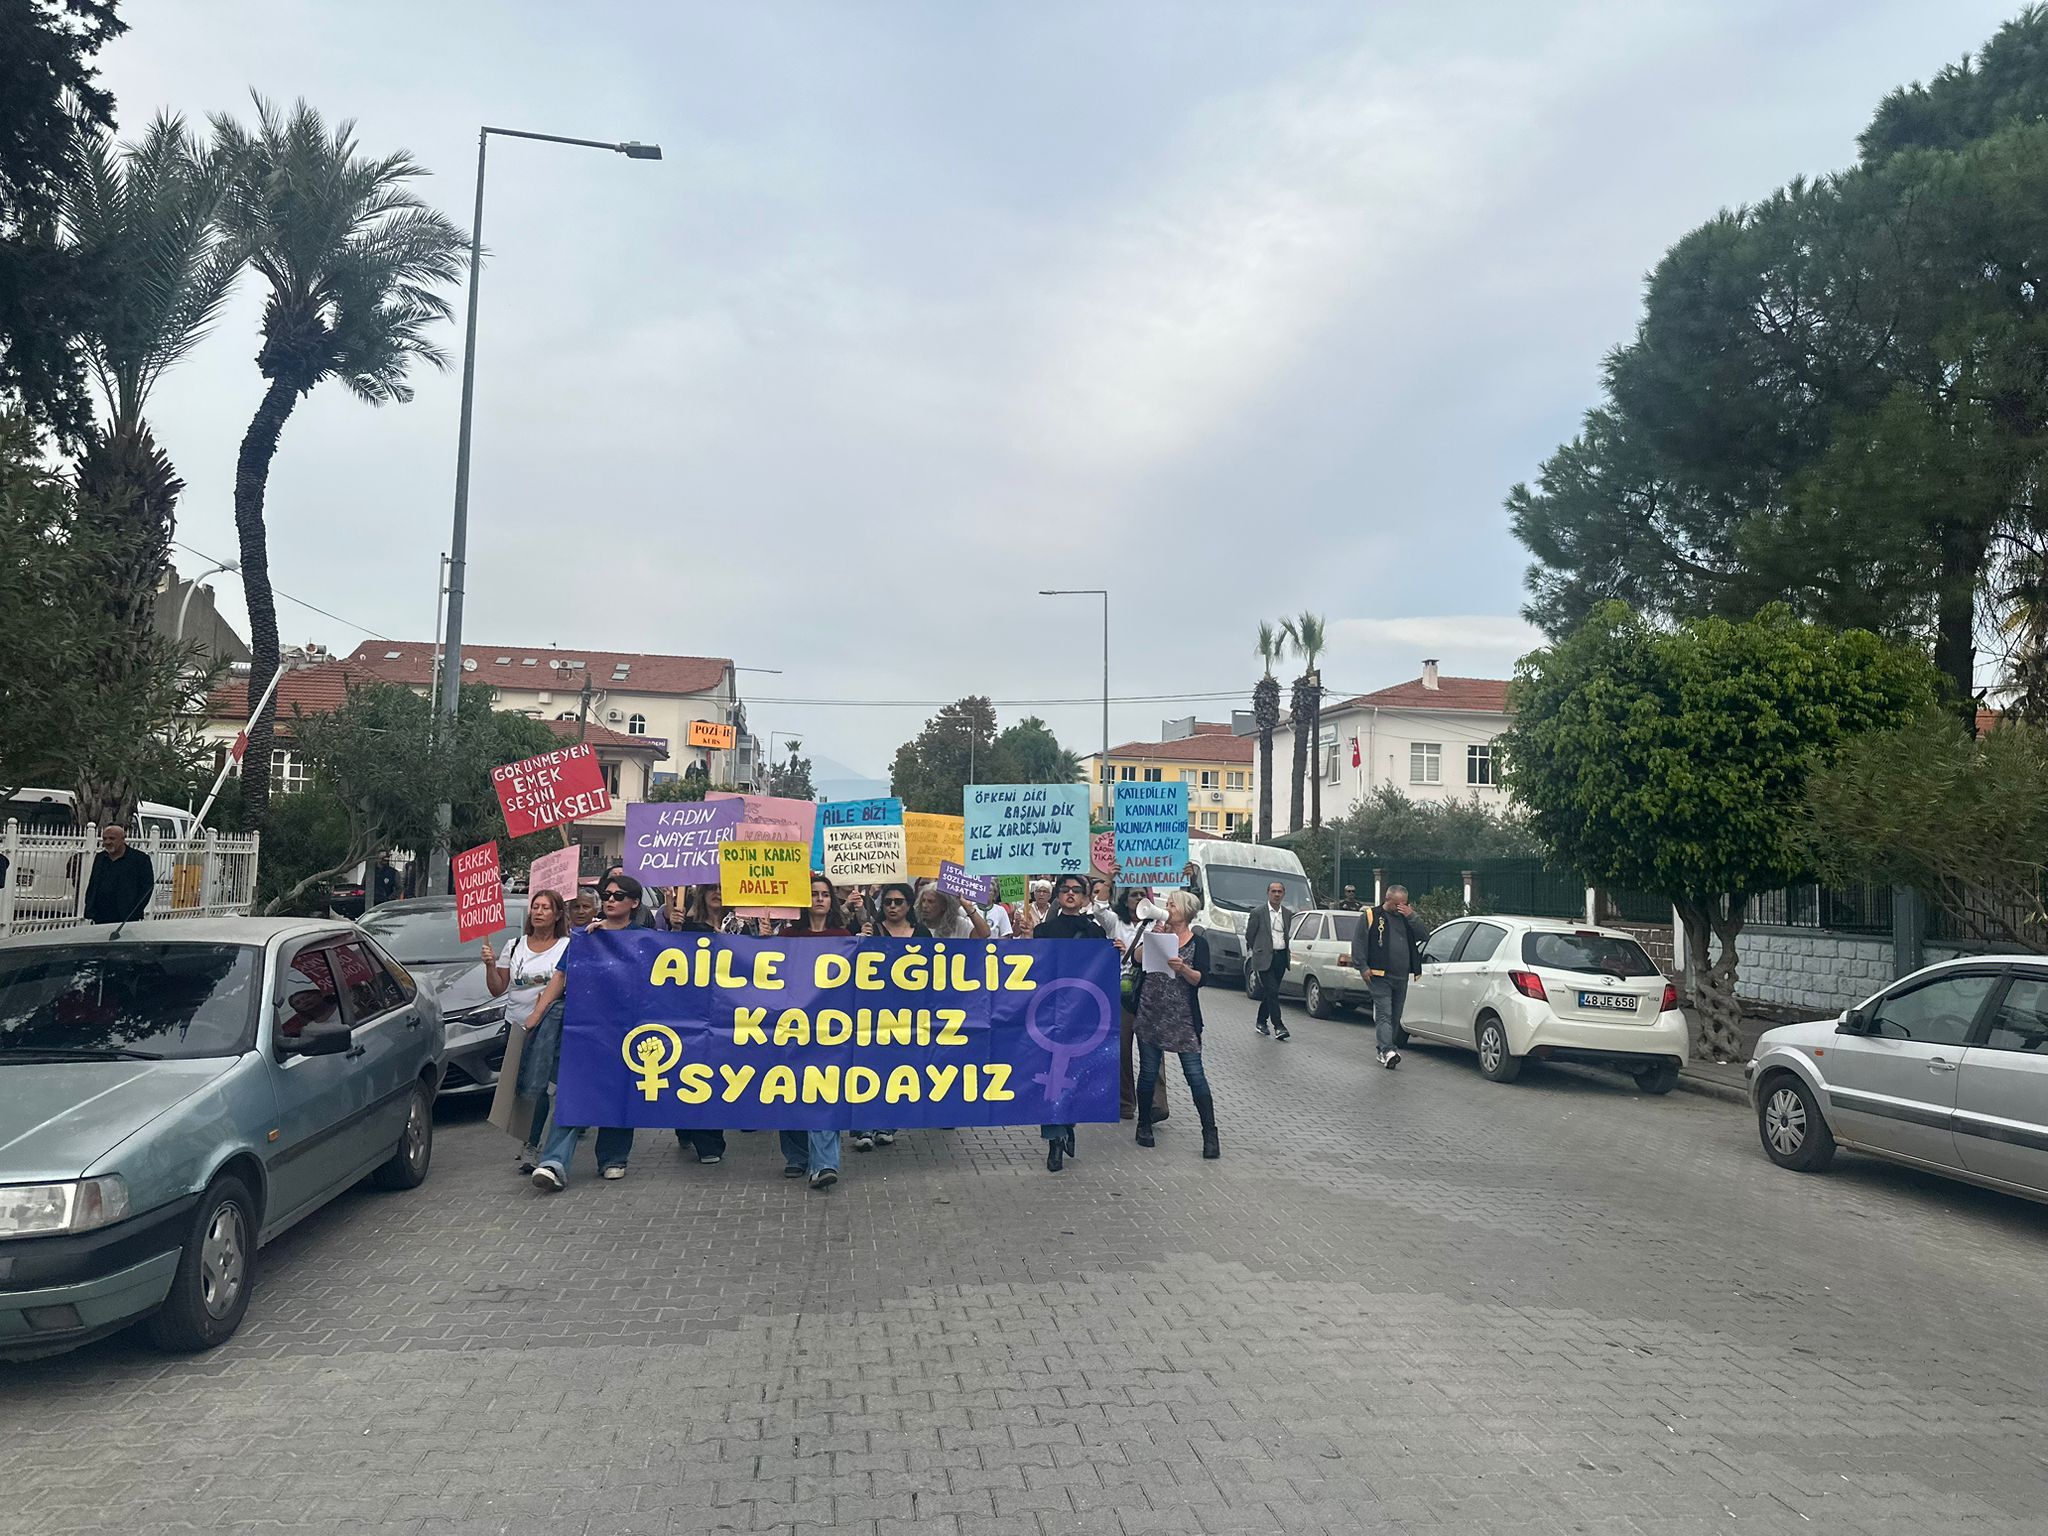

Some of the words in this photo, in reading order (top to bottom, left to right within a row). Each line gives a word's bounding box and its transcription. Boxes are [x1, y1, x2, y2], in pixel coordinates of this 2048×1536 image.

[512, 766, 563, 794] EMEK
[506, 784, 556, 812] SESİNİ
[975, 789, 1016, 804] ÖFKENİ
[1022, 788, 1047, 802] DİRİ
[1117, 786, 1177, 800] KATLEDİLEN
[527, 788, 606, 828] YÜKSELT
[658, 807, 717, 826] KADIN
[822, 806, 855, 825] AİLE
[862, 802, 887, 821] BİZİ
[1004, 804, 1047, 821] BAŞINI
[1050, 802, 1075, 817] DİK
[1125, 803, 1178, 817] KADINLARI
[637, 822, 734, 848] CİNAYETLERİ
[839, 831, 863, 841] YARGI
[970, 825, 992, 839] KIZ
[1115, 821, 1153, 834] AKLINIZA
[458, 848, 493, 873] ERKEK
[723, 847, 757, 861] ROJİN
[834, 850, 900, 862] AKLINIZDAN
[971, 842, 1003, 861] ELİNİ
[1008, 842, 1035, 858] SIKI
[1041, 841, 1073, 856] TUT
[831, 861, 896, 875] GEÇİRMEYİN
[1125, 854, 1173, 868] ADALETİ
[459, 866, 501, 891] VURUYOR
[739, 879, 789, 894] ADALET
[462, 882, 501, 909] DEVLET
[460, 903, 504, 929] KORUYOR
[649, 937, 786, 990] AİLE
[813, 943, 1037, 991] DEĞİLİZ
[1584, 995, 1598, 1006] 48
[1599, 996, 1613, 1006] JE
[1614, 997, 1635, 1008] 658
[733, 1007, 968, 1047] KADINIZ
